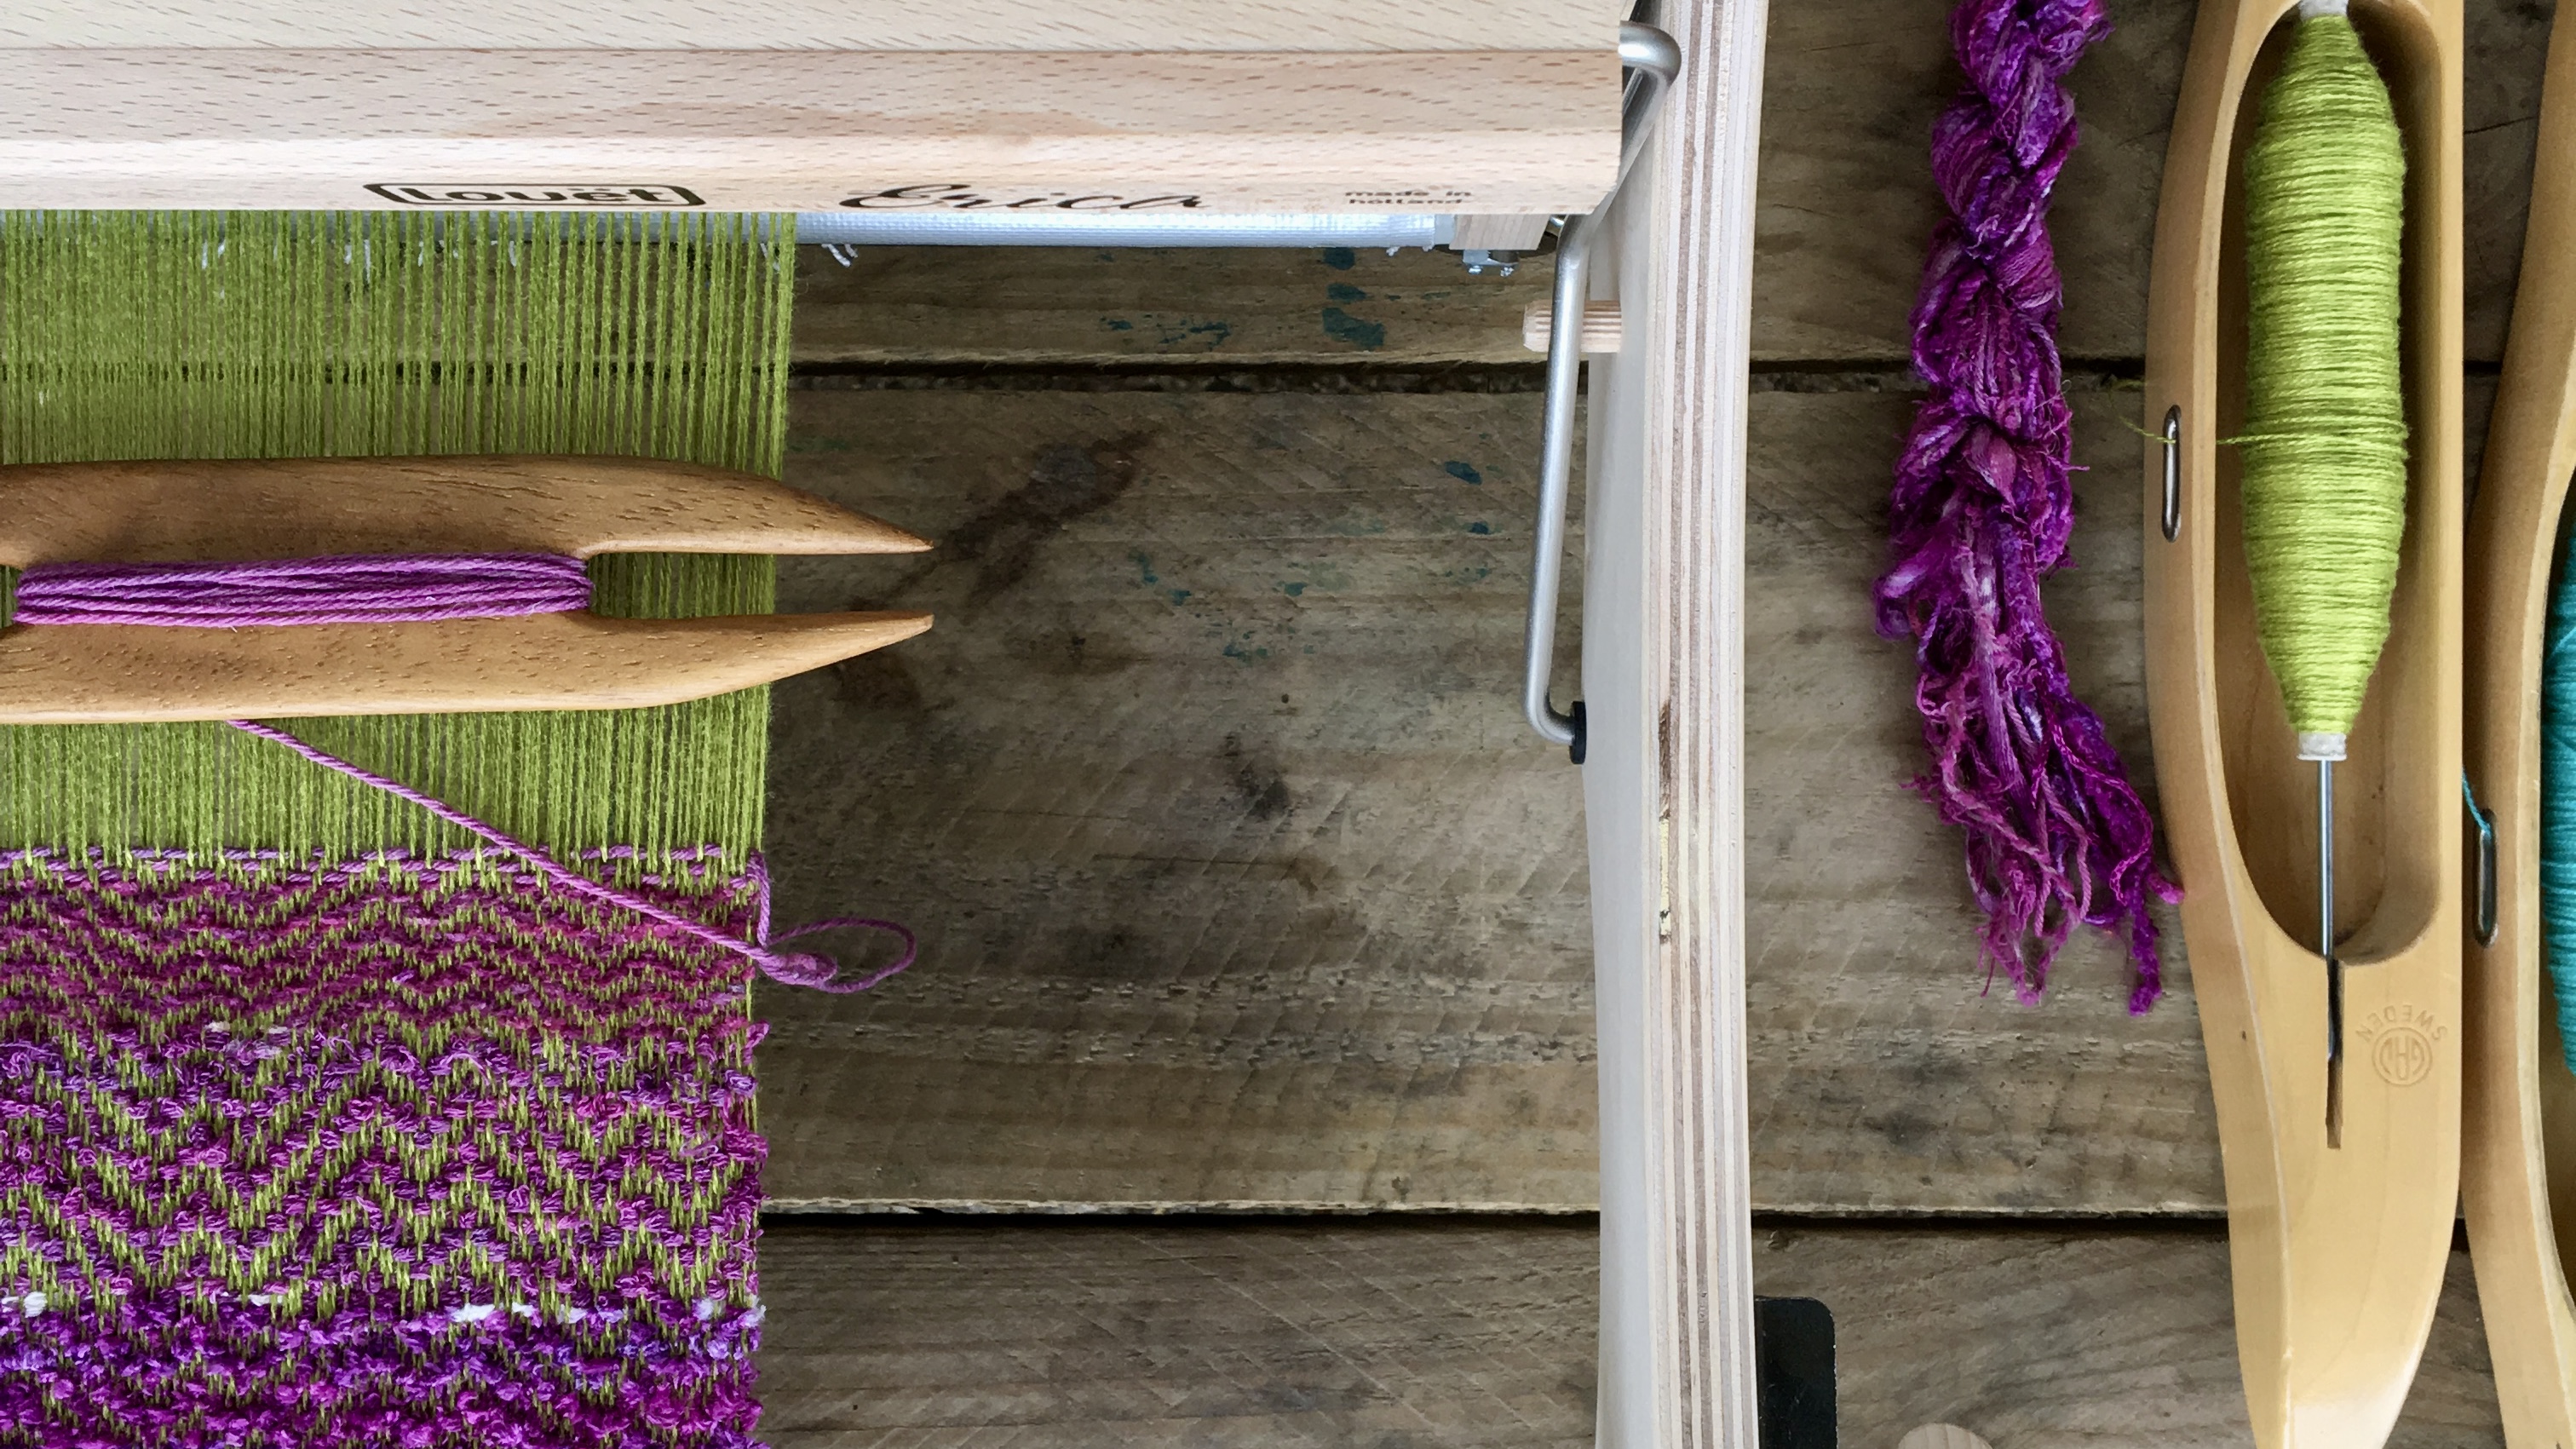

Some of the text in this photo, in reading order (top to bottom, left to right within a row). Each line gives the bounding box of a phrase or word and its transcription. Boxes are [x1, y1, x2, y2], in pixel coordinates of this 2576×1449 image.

[399, 187, 674, 202] Louët
[838, 184, 1210, 210] Erica
[2355, 1004, 2447, 1043] SWEDEN
